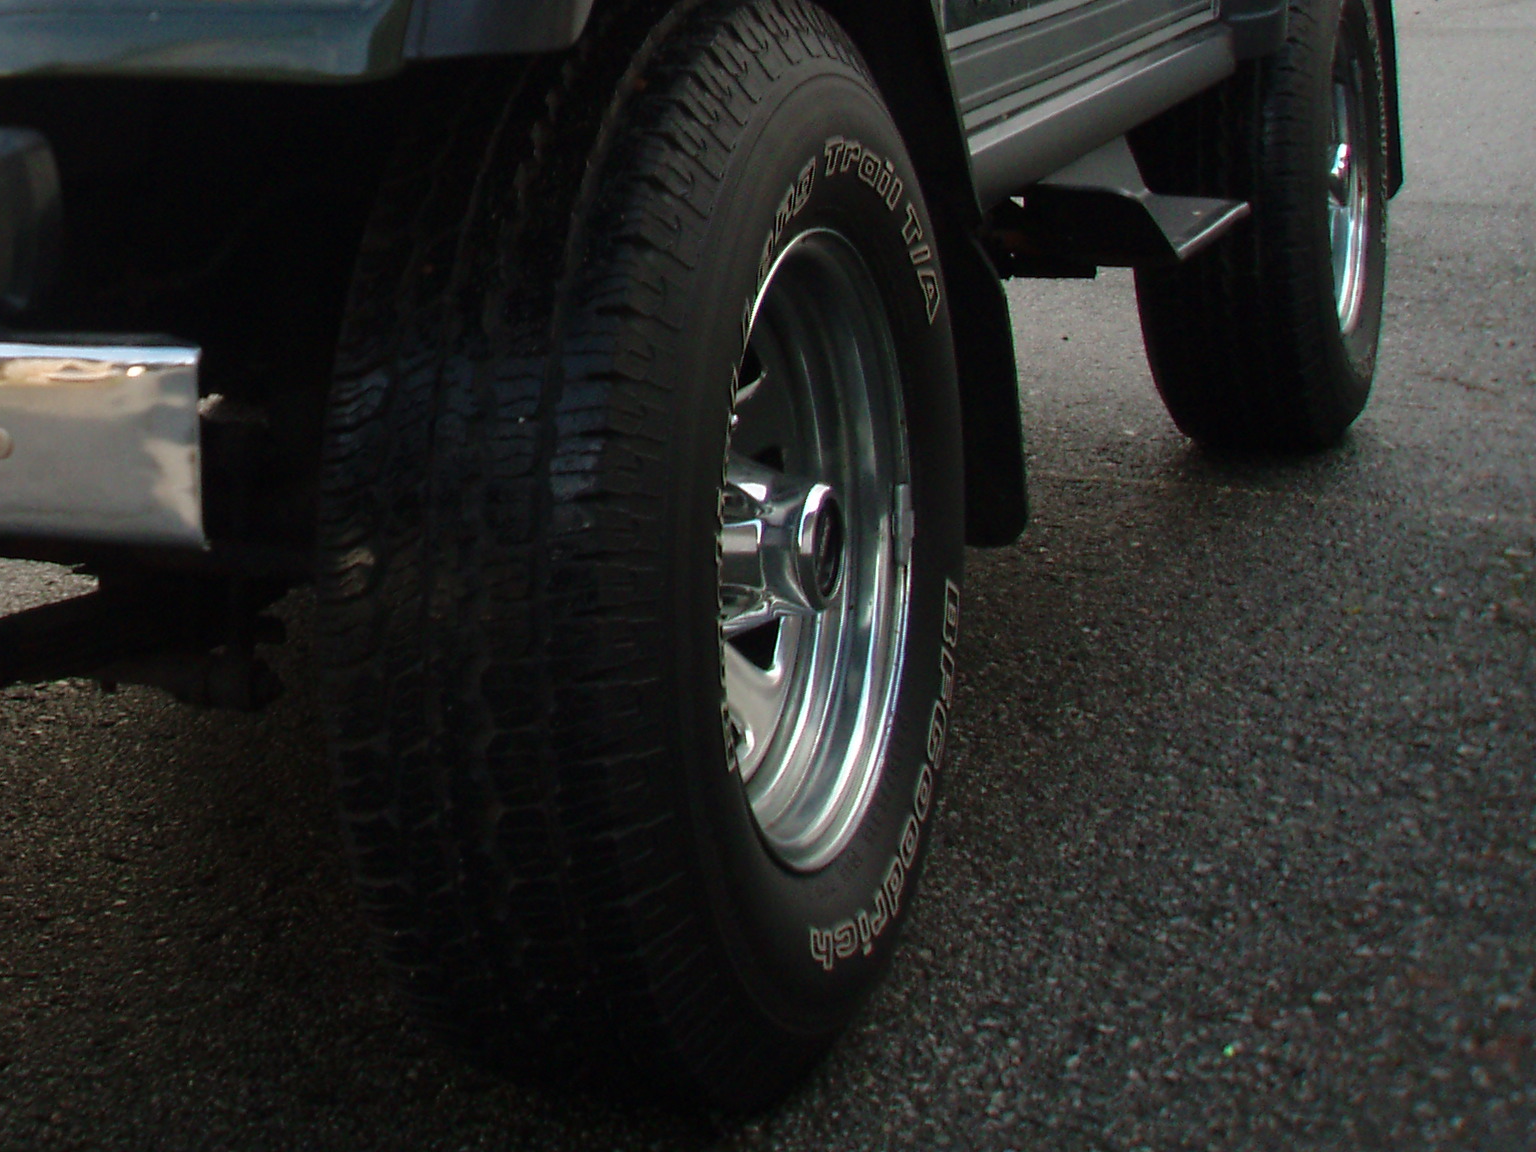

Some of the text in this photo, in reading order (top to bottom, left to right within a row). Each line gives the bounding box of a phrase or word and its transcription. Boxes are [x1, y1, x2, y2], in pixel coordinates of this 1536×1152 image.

[824, 135, 903, 212] Trail
[901, 202, 940, 326] T/A
[810, 578, 960, 970] BFGoodrich
